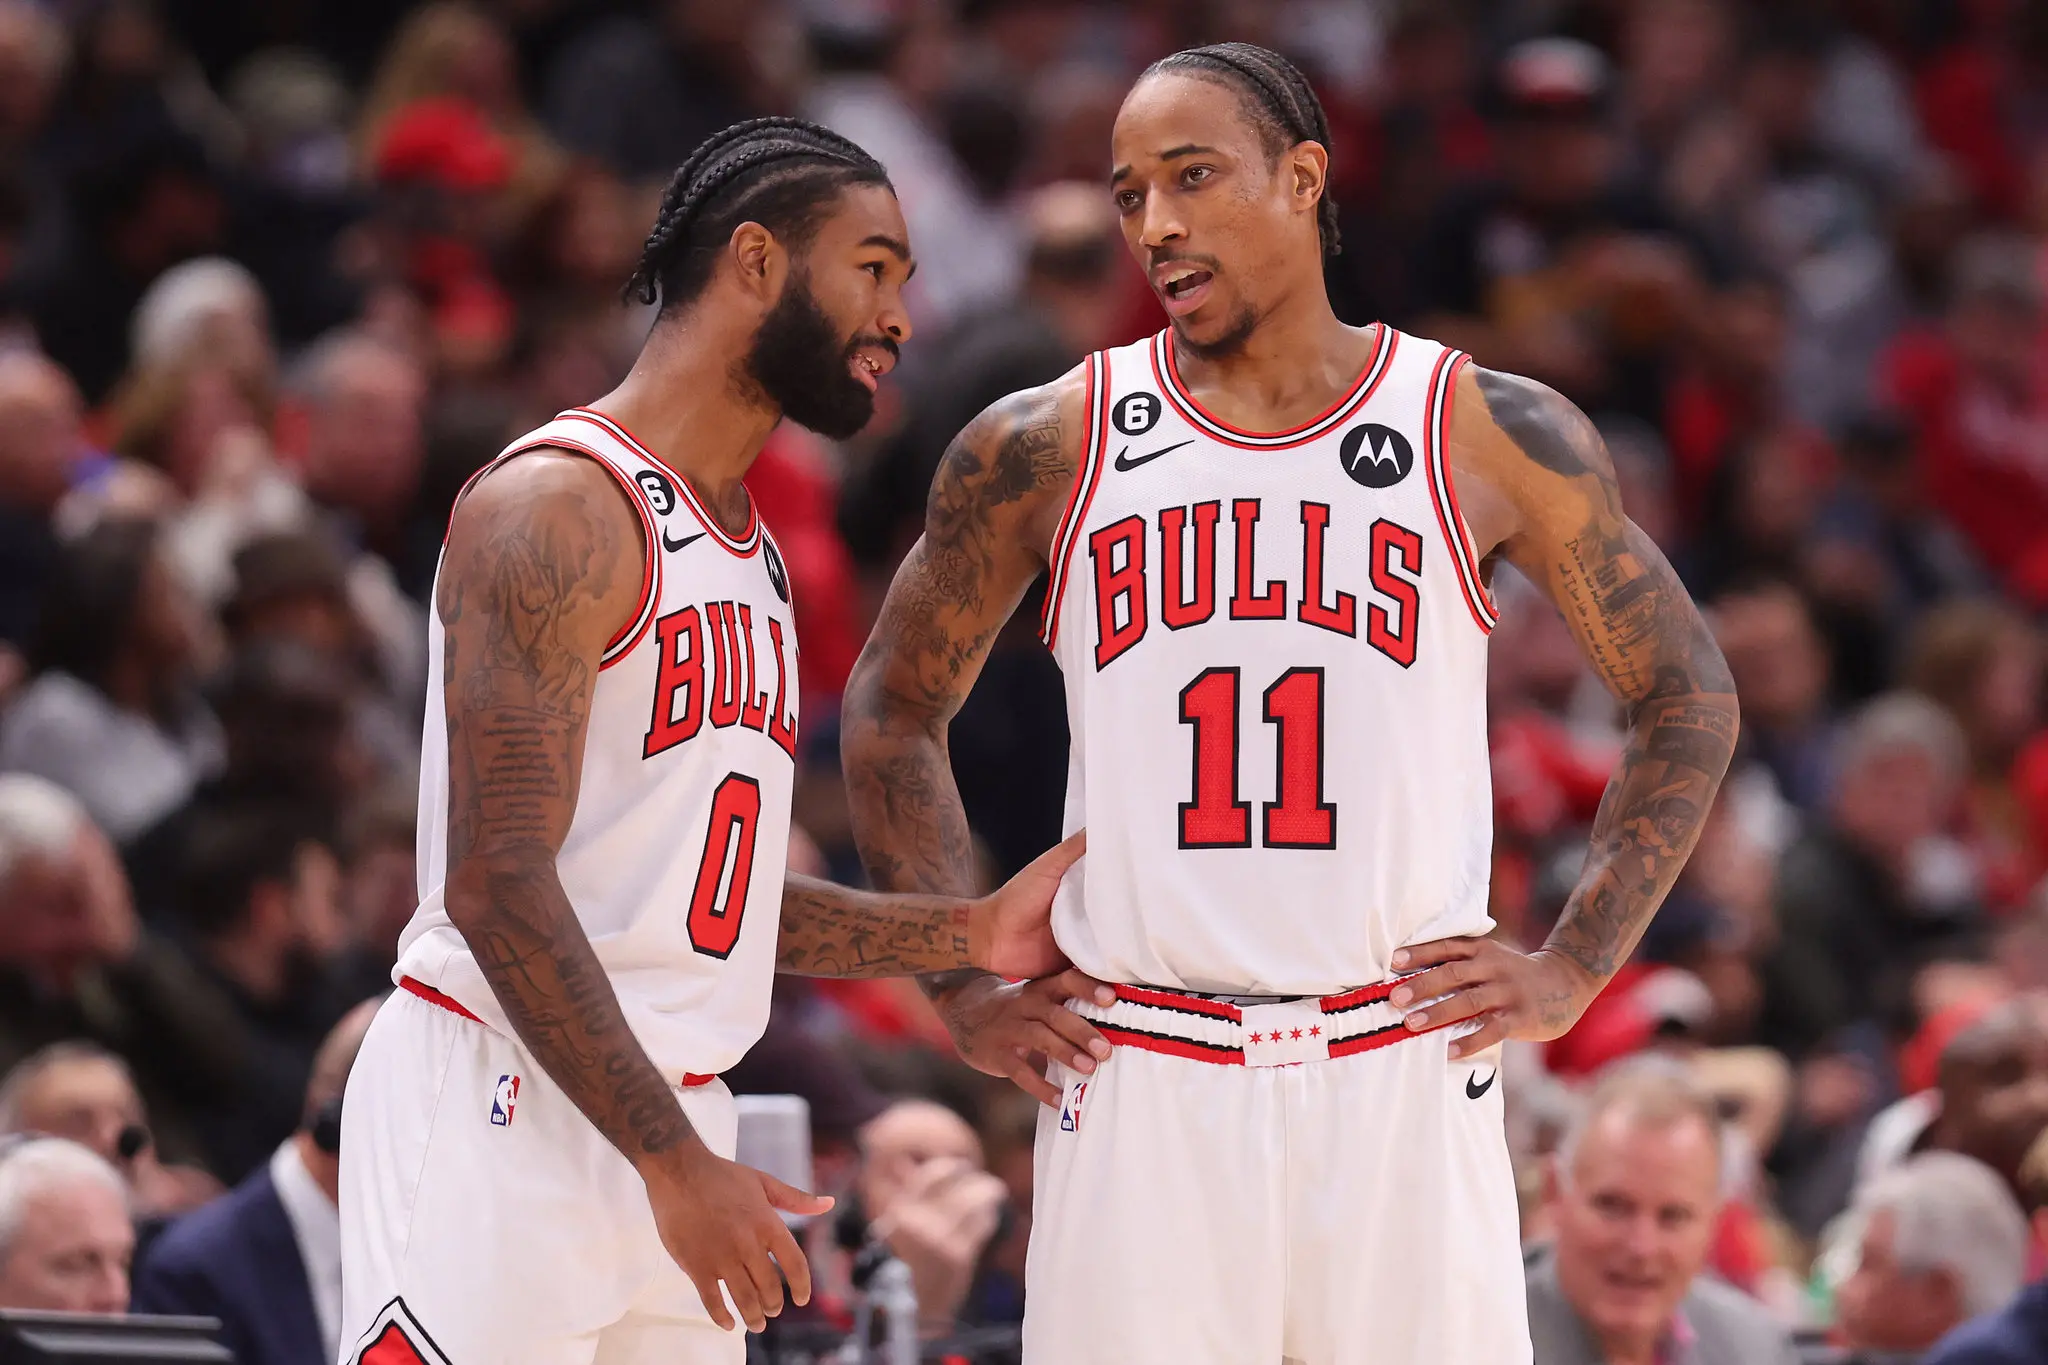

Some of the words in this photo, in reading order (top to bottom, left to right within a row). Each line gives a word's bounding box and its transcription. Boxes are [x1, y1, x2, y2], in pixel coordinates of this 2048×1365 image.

[641, 476, 669, 511] 6
[1123, 398, 1150, 428] 6
[1089, 498, 1424, 673] BULLS
[642, 600, 800, 764] BULL
[1178, 666, 1337, 850] 11
[686, 771, 761, 961] 0
[493, 1113, 505, 1123] NBA
